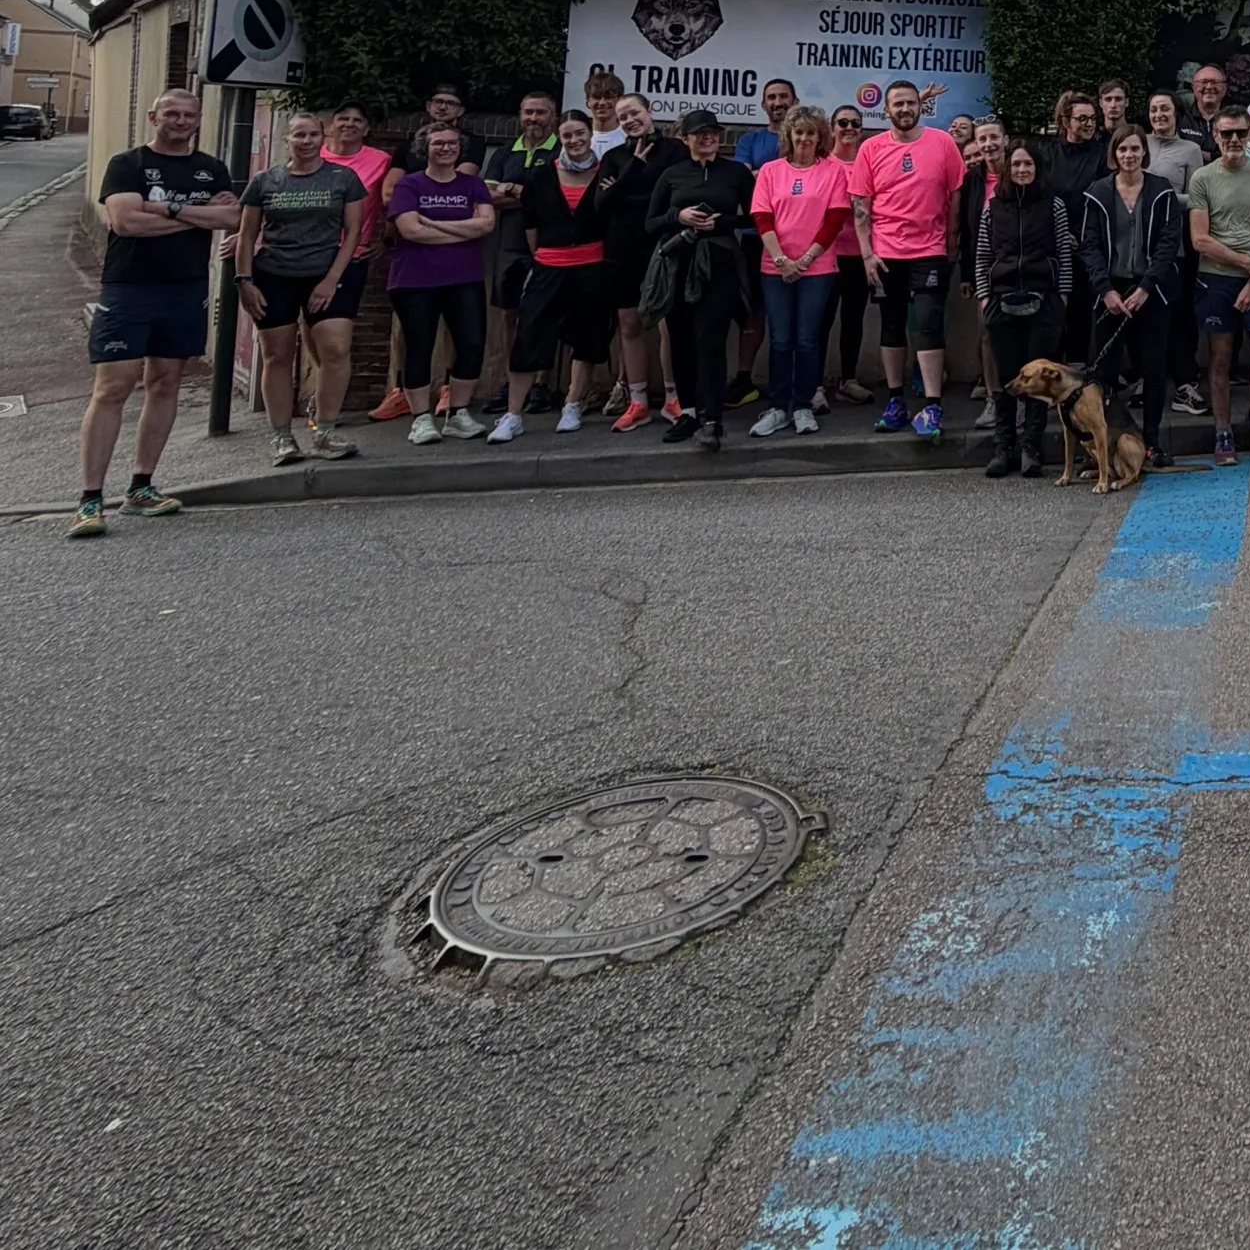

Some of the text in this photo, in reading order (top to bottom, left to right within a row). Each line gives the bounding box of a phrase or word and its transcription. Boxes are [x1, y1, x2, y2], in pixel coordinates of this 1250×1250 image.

[818, 5, 967, 40] SÉJOUR SPORTIF
[795, 42, 986, 74] TRAINING EXTÉRIEUR
[632, 65, 758, 97] TRAINING
[679, 101, 757, 116] PHYSIQUE
